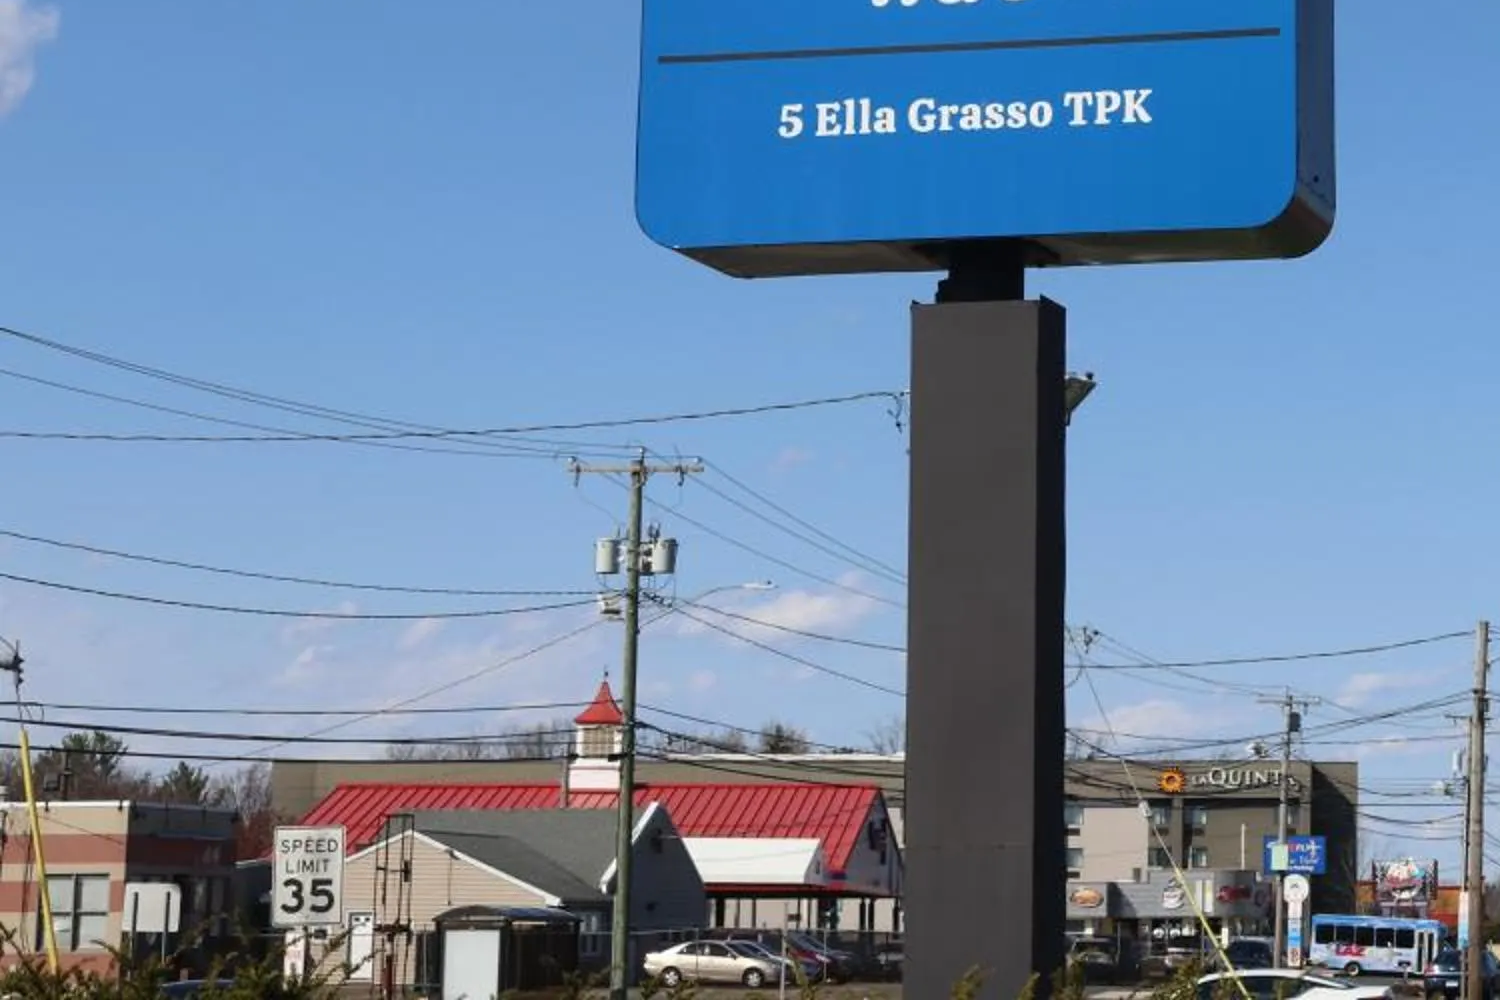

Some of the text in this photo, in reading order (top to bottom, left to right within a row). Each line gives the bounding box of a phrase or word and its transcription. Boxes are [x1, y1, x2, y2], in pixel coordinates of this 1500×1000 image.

[778, 88, 1154, 139] 5 Ella Grasso TPK
[281, 839, 338, 853] SPEED
[285, 859, 330, 874] LIMIT
[280, 878, 335, 913] 35
